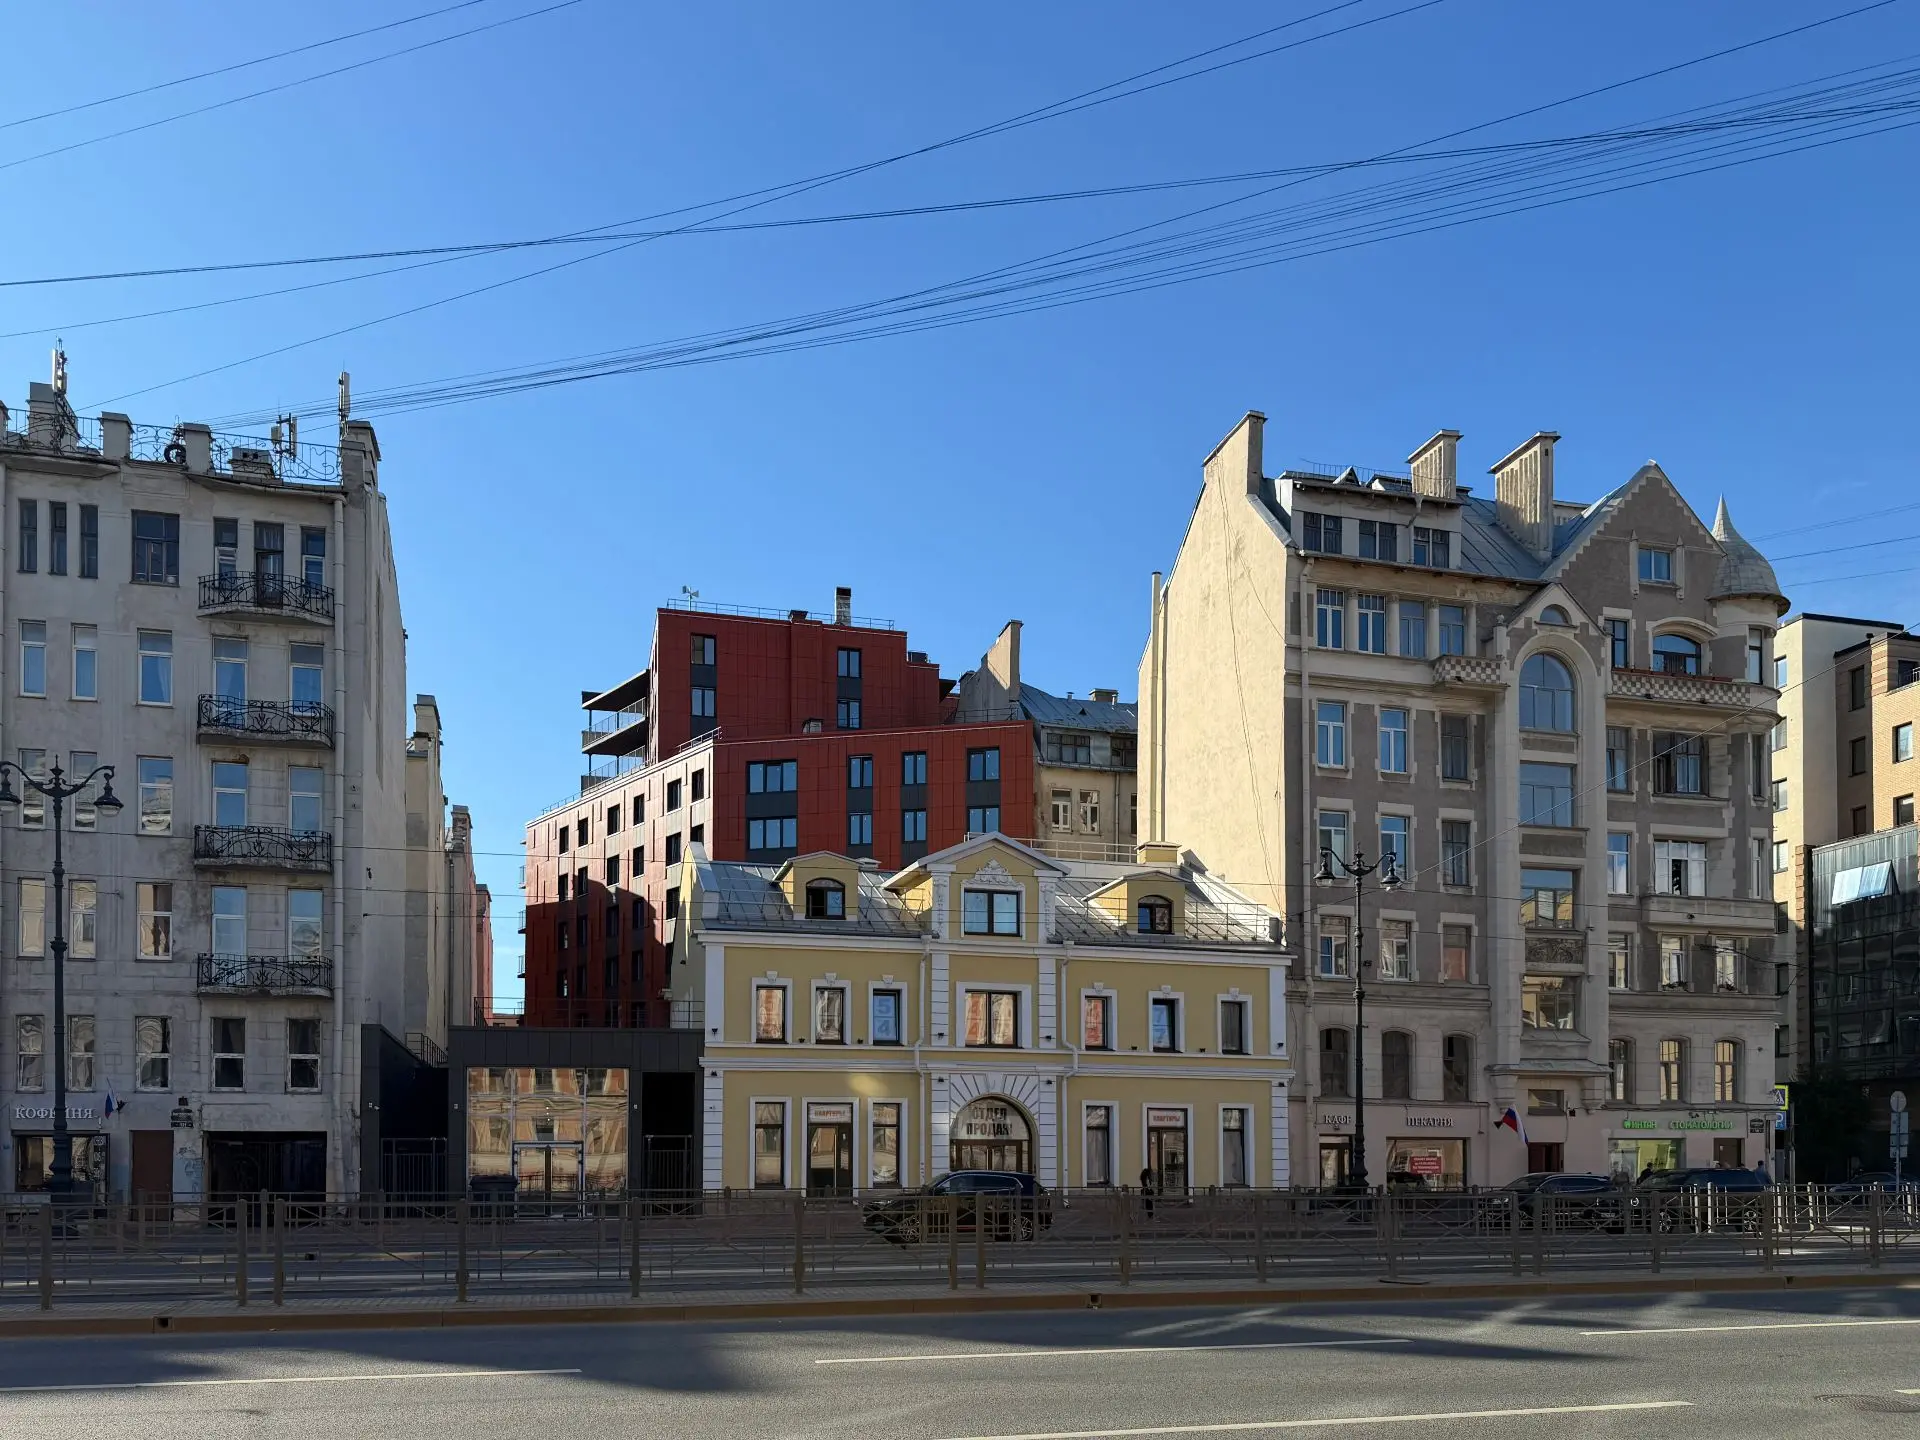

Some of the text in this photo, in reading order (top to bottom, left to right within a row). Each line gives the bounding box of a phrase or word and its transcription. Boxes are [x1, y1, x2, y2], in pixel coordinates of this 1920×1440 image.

[974, 1107, 1007, 1121] ОТДЕЛ
[1325, 1114, 1351, 1124] КАФЕ
[1407, 1117, 1454, 1127] ПЕКАРНЯ
